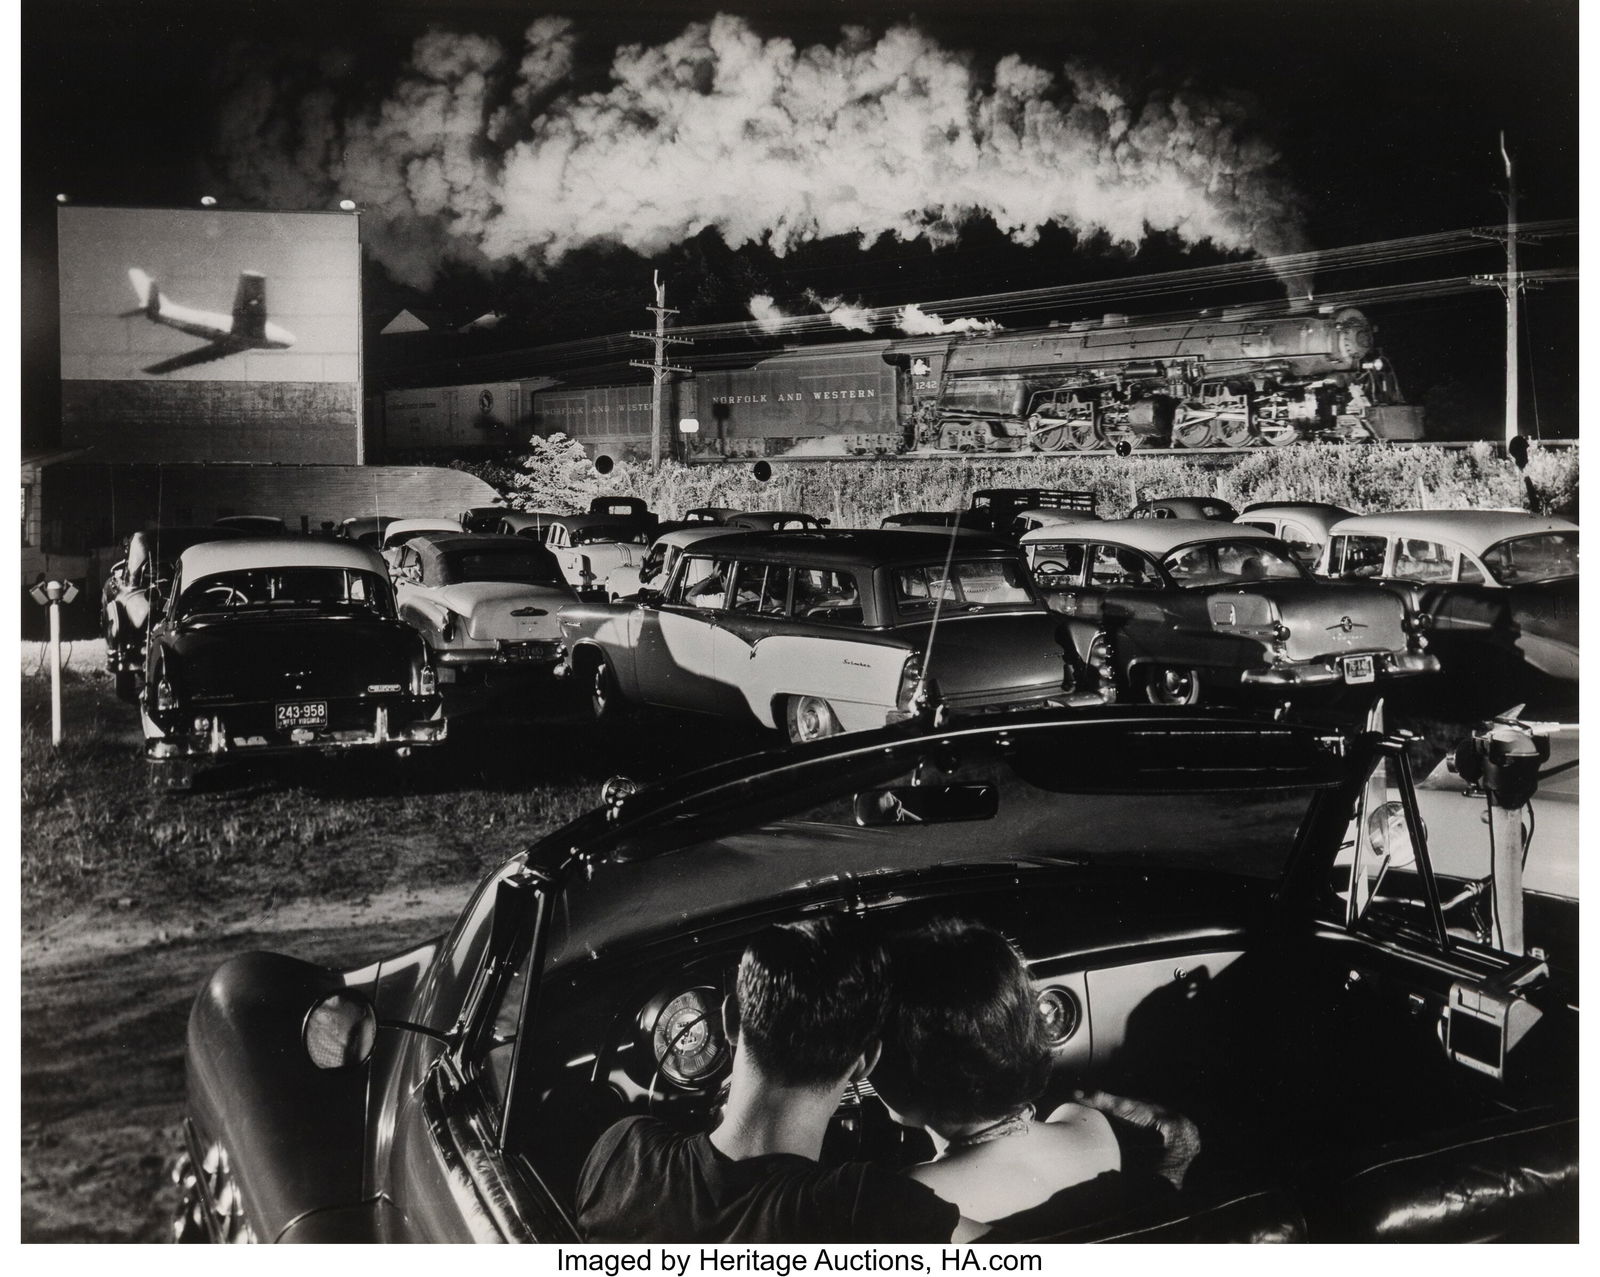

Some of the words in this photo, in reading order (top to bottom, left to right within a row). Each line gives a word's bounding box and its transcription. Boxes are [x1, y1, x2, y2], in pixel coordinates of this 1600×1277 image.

[915, 380, 937, 390] 1242
[712, 393, 768, 405] NORFOLK
[777, 392, 803, 403] AND
[813, 388, 876, 400] WESTERN
[591, 404, 610, 414] AND
[279, 704, 324, 719] 243-958
